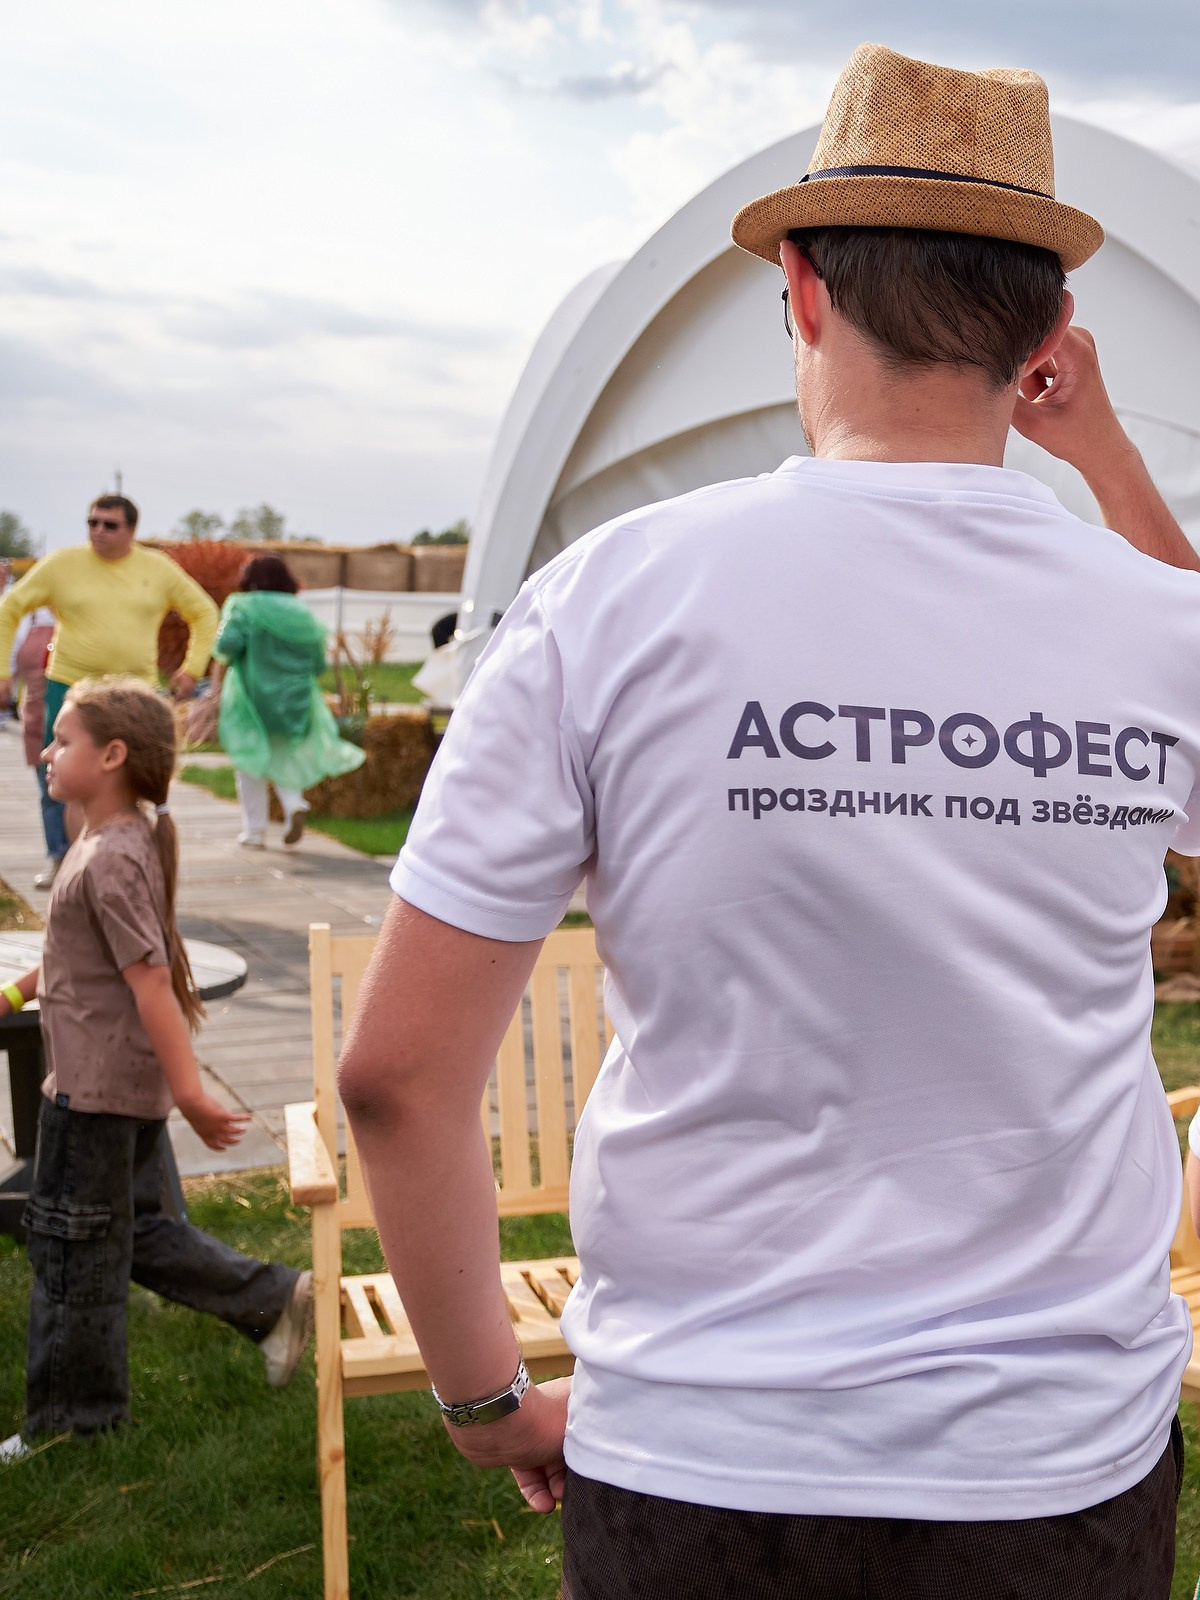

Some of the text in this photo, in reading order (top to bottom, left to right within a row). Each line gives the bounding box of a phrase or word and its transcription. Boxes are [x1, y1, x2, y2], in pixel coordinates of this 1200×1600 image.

[726, 700, 1180, 785] АСТРОФЕСТ
[727, 787, 1175, 831] праздник под звёздами
